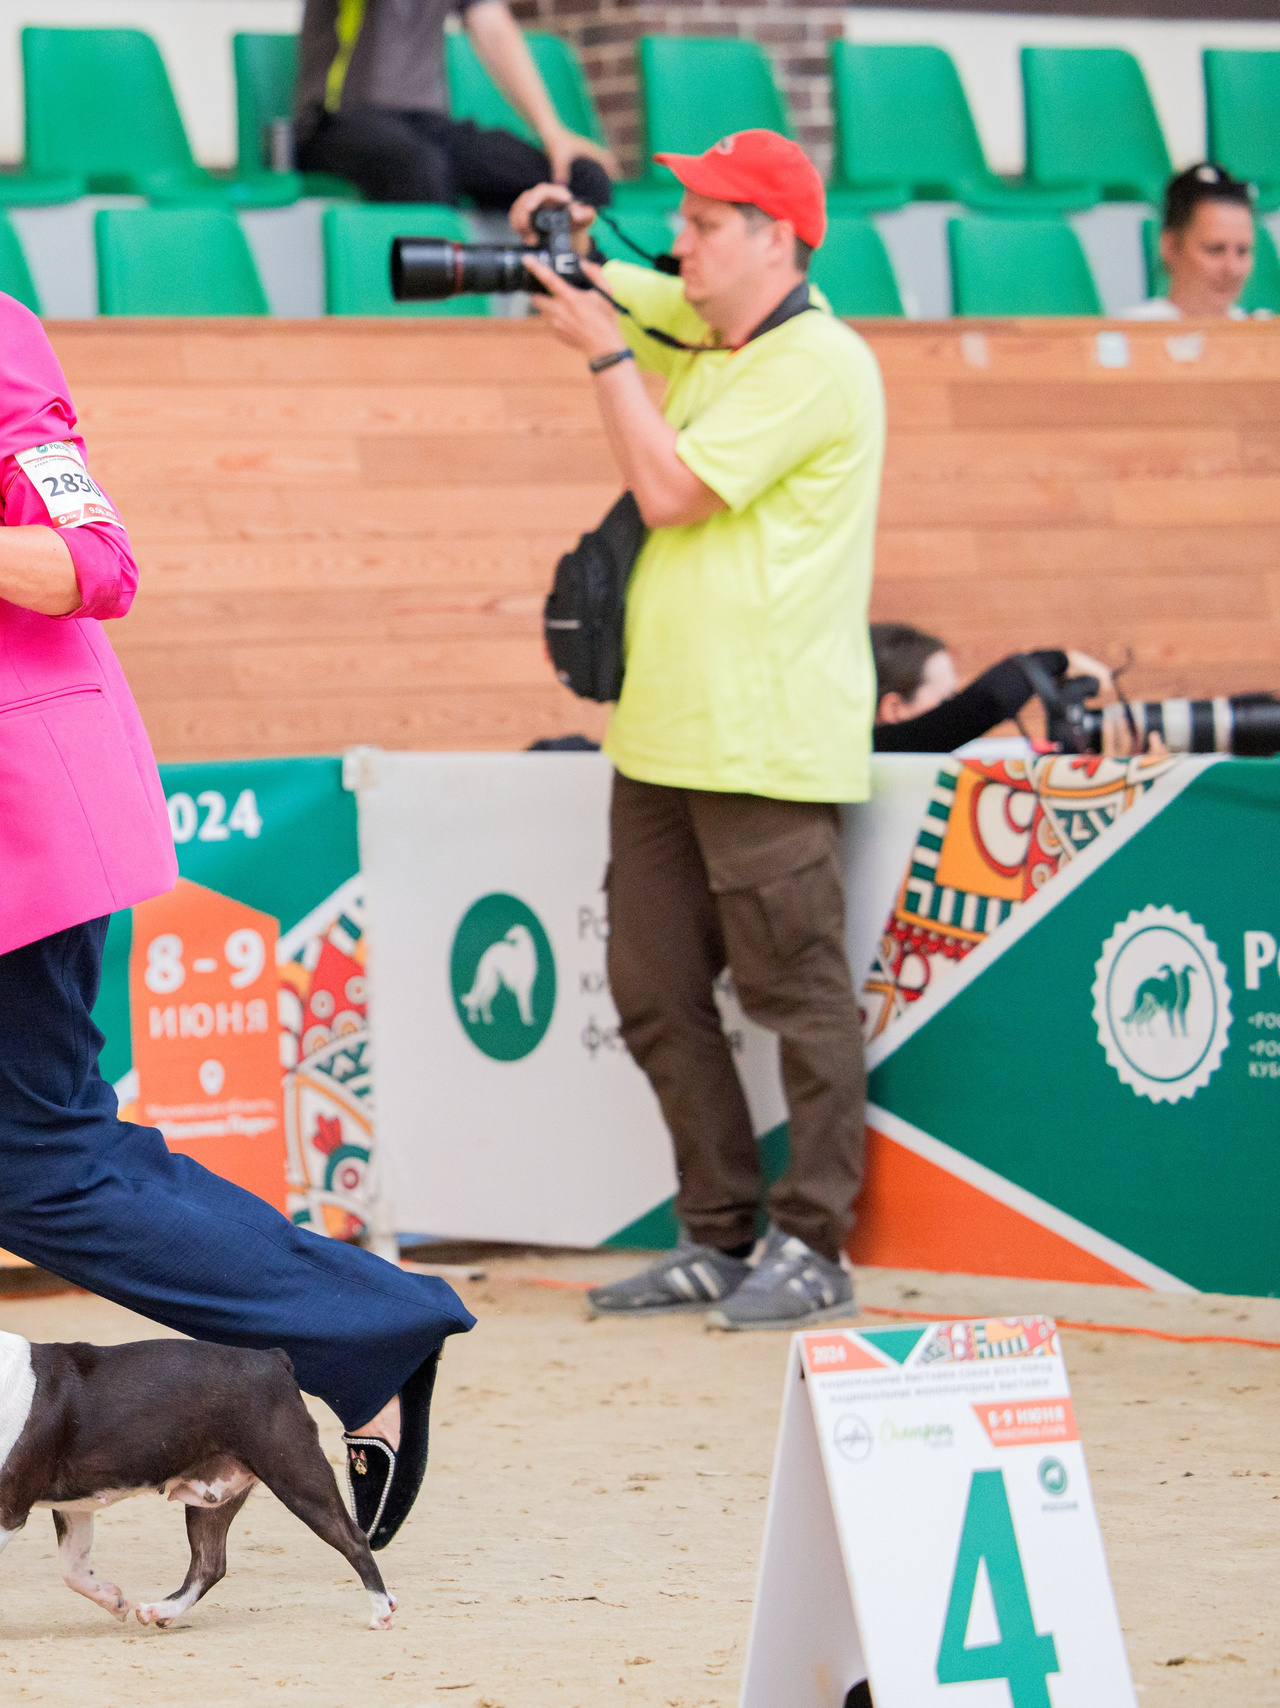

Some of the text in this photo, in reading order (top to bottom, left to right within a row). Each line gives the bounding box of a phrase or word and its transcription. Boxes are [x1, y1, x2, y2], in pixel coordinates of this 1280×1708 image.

[42, 472, 102, 498] 2830
[167, 788, 262, 844] 024
[936, 1466, 1061, 1708] 4
